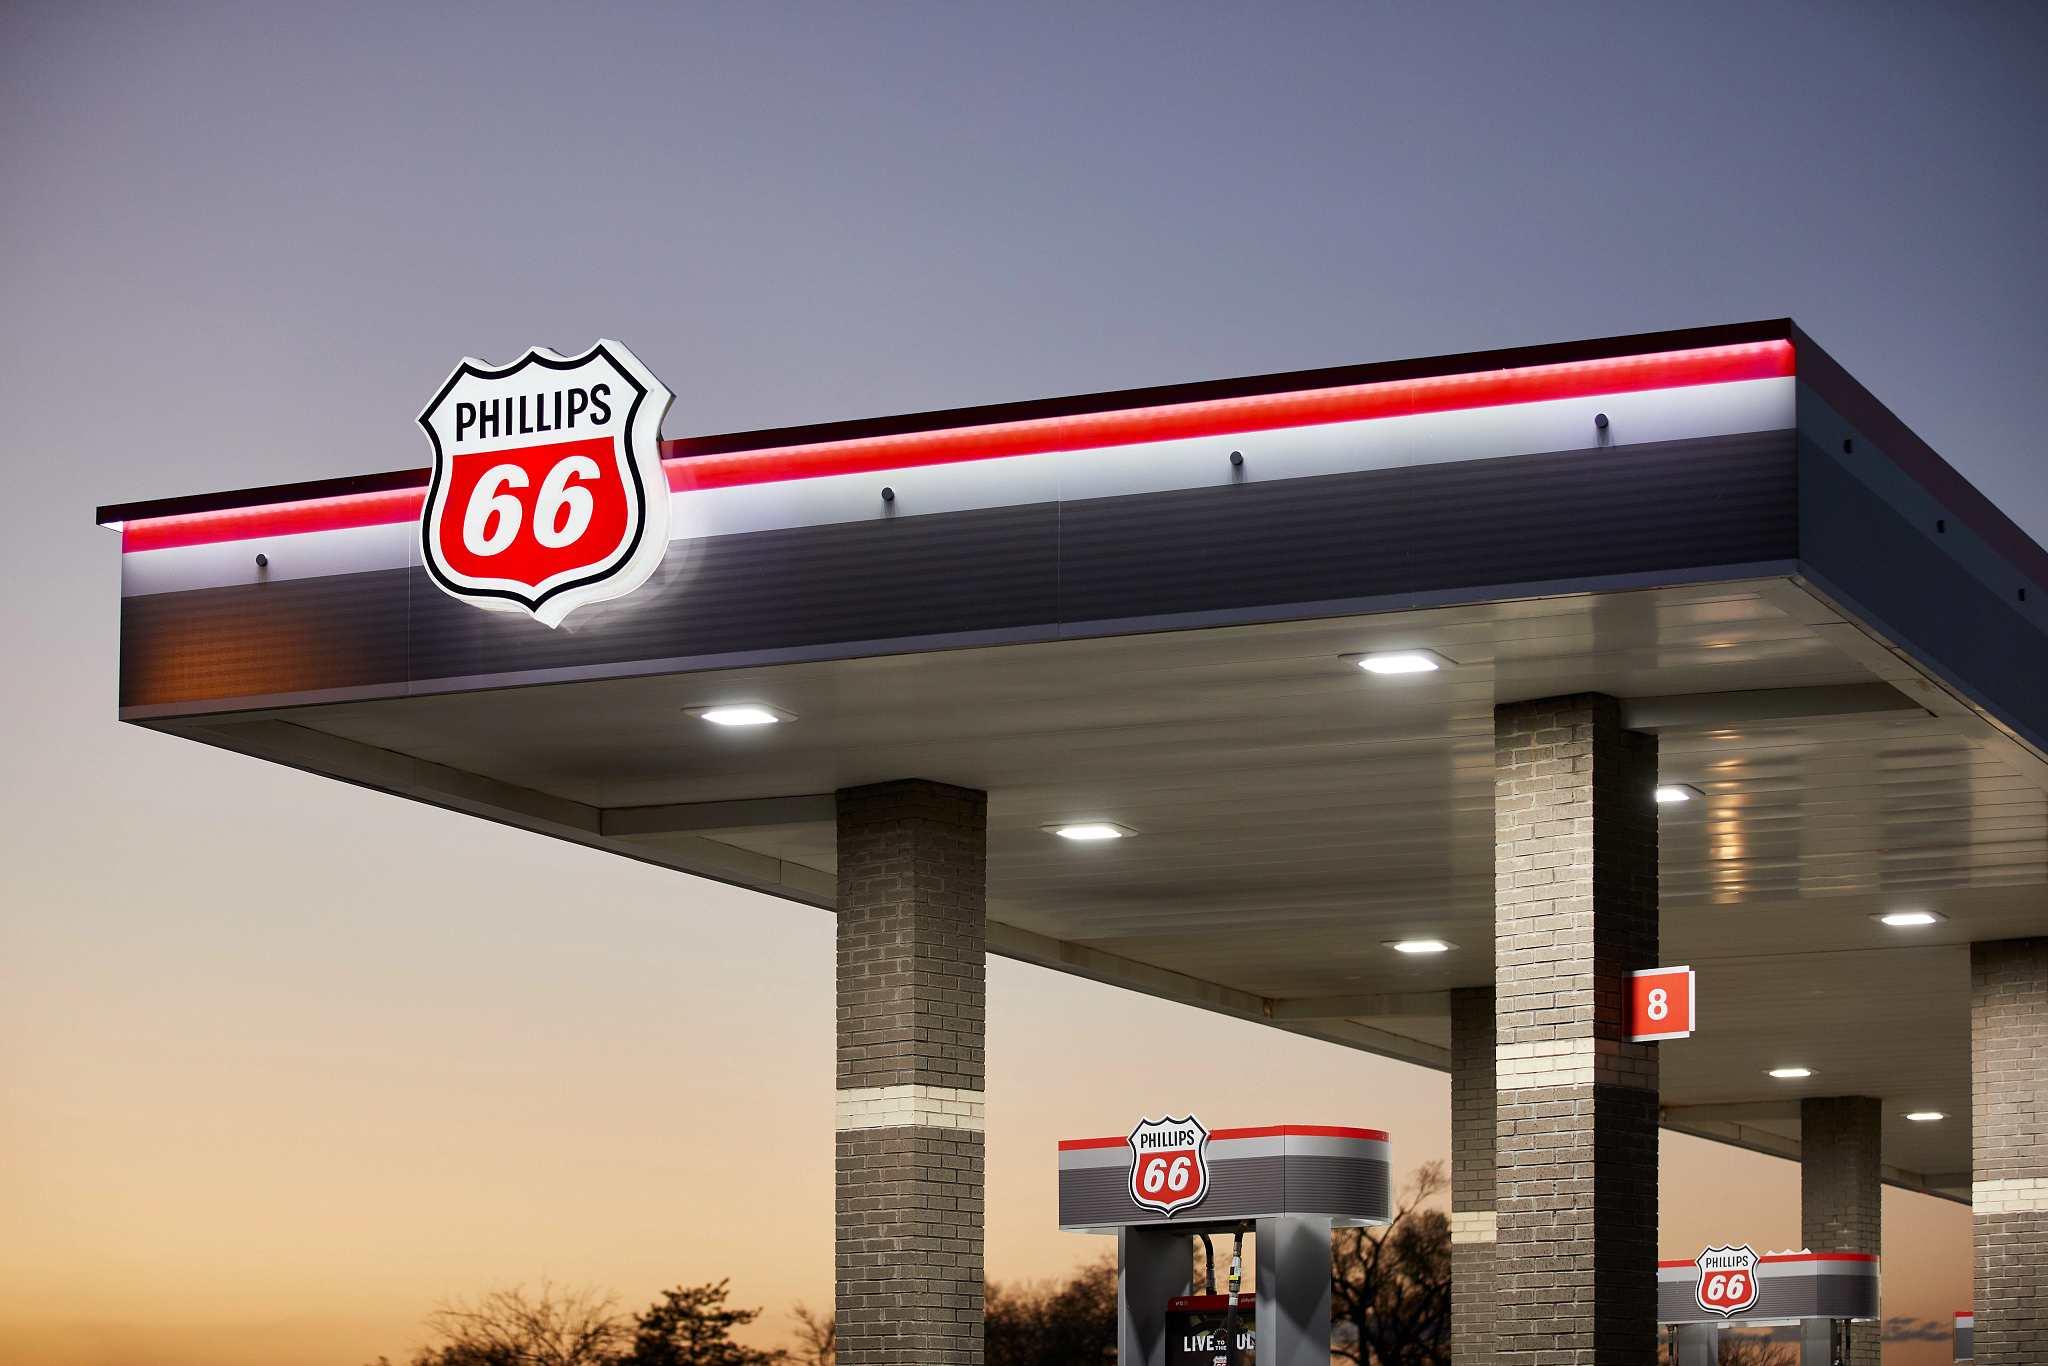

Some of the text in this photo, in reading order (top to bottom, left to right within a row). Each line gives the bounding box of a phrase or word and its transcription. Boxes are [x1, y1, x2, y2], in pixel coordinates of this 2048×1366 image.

[455, 383, 612, 442] PHILLIPS
[463, 455, 601, 557] 66
[1647, 988, 1668, 1020] 8
[1140, 1129, 1195, 1148] PHILLIPS
[1143, 1156, 1191, 1193] 66
[1706, 1255, 1749, 1268] PHILLIPS
[1707, 1274, 1746, 1300] 66
[1183, 1334, 1215, 1352] LIVE
[1236, 1333, 1255, 1350] UL
